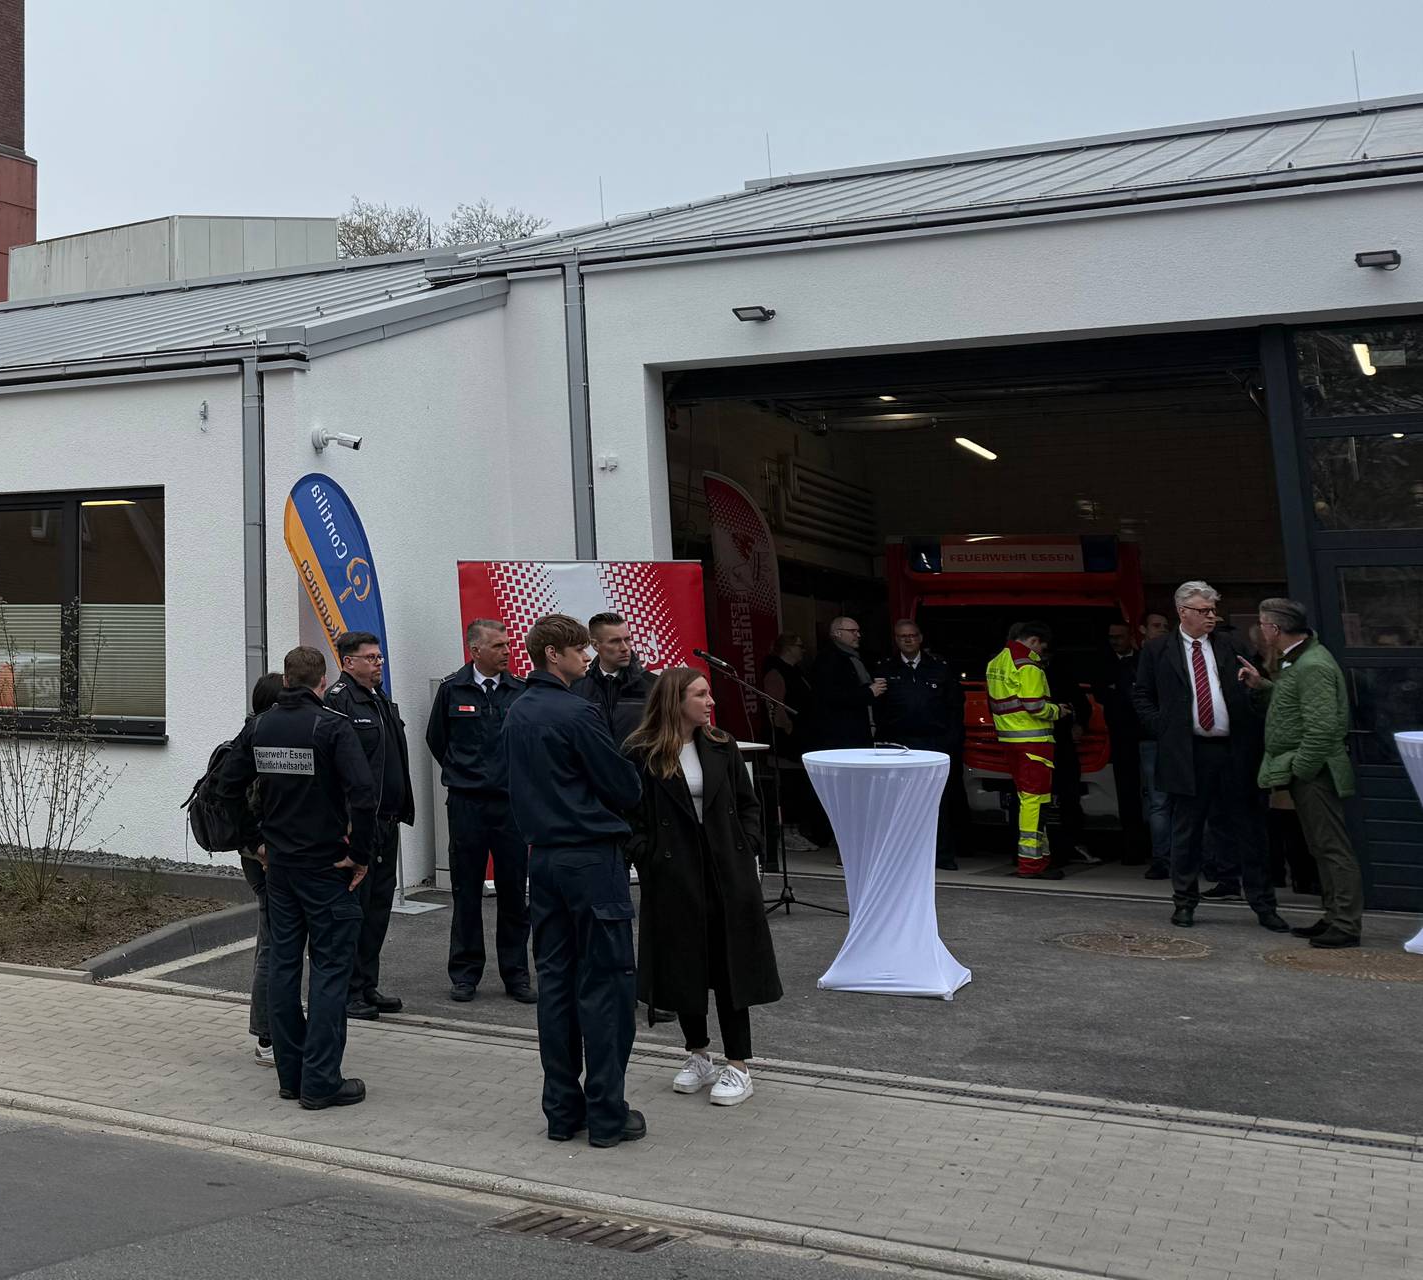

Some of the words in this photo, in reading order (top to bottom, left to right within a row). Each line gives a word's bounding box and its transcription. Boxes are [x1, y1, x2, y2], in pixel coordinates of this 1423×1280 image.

[950, 553, 1027, 562] FEUERWEHR
[1031, 553, 1075, 562] ESSEN
[730, 600, 742, 647] ESSEN
[737, 590, 758, 714] FEUERWEHR
[255, 749, 288, 760] Feuerwehr
[289, 750, 312, 760] Essen
